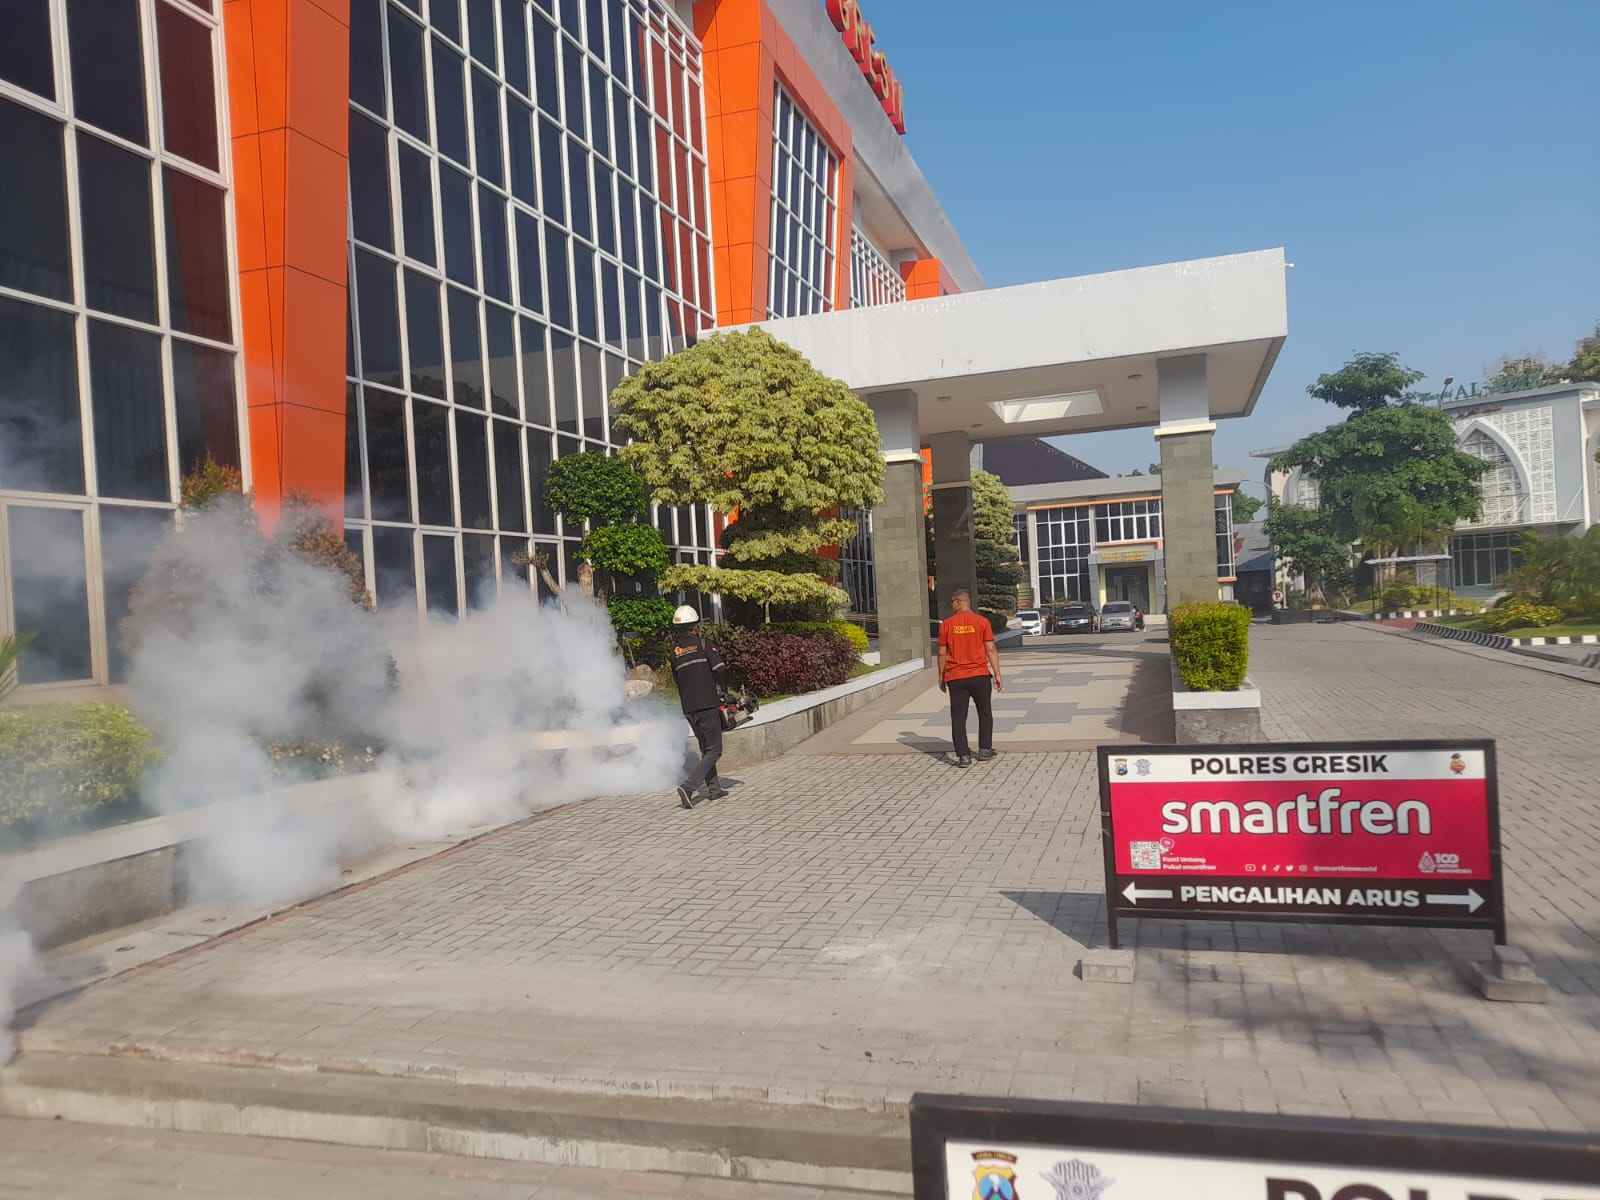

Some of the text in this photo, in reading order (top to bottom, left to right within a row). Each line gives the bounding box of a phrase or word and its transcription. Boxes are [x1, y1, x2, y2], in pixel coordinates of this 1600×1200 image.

[1191, 755, 1388, 775] POLRES GRESIK
[1161, 787, 1432, 835] smartfren
[1180, 886, 1420, 908] PENGALIHAN ARUS
